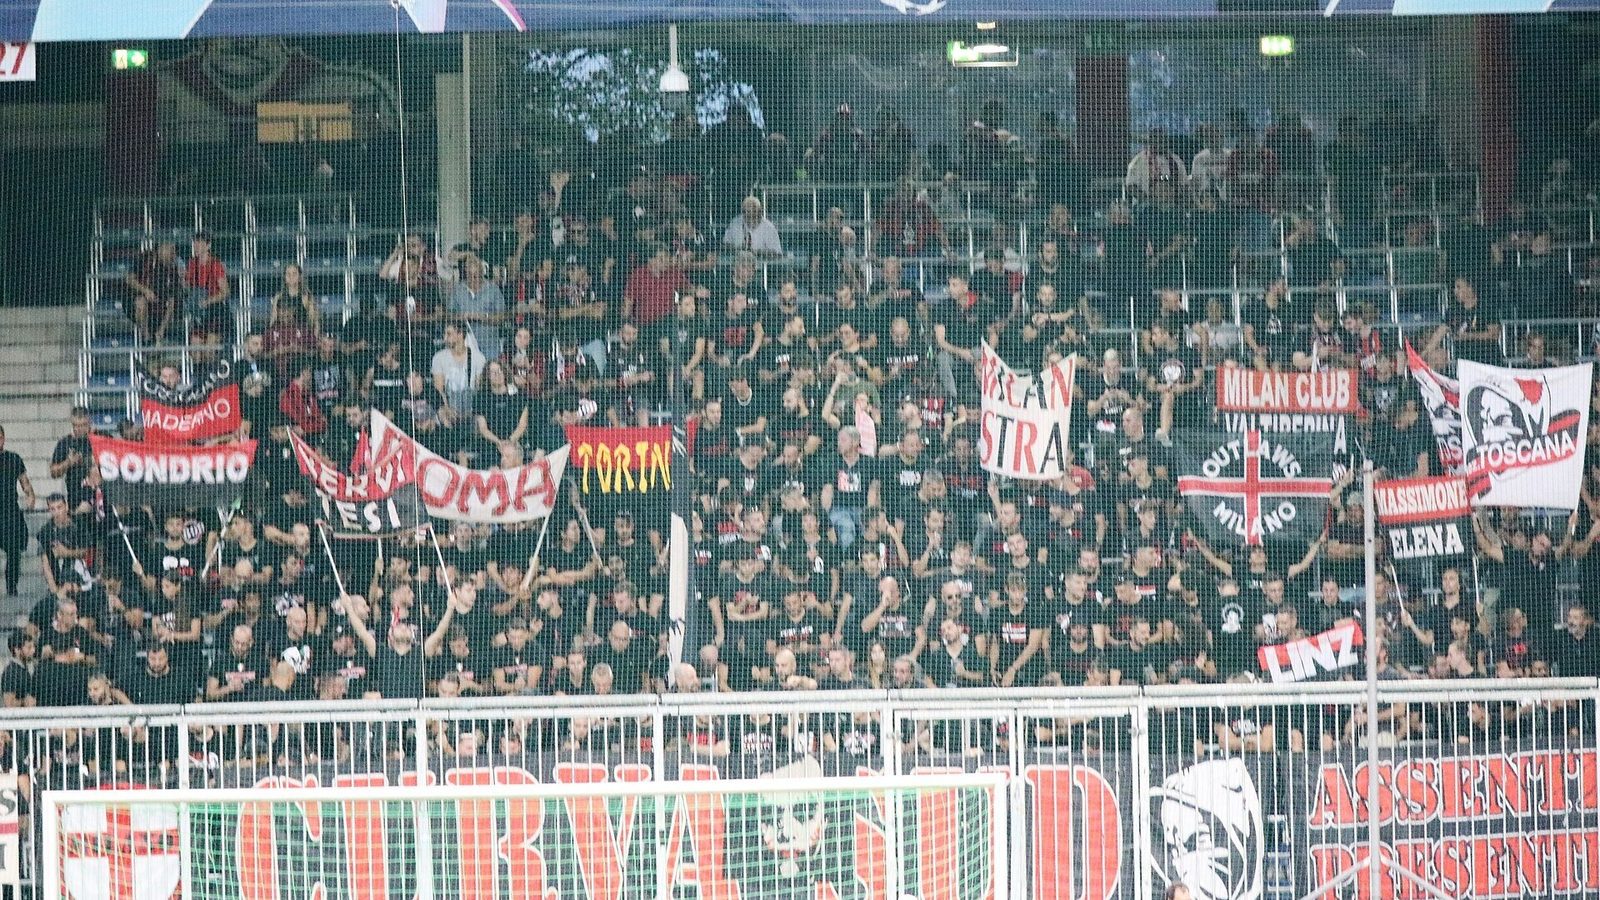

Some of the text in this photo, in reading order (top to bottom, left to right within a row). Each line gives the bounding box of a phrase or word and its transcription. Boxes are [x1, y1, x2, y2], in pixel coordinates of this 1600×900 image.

[1224, 368, 1350, 409] MILAN CLUB
[98, 451, 249, 485] SONDRIO
[1476, 429, 1576, 469] TOSCANA
[1374, 479, 1468, 517] MASSIMONE
[1212, 500, 1297, 537] MILANO
[1388, 523, 1465, 559] ELENA
[1263, 624, 1359, 684] LINZ
[1308, 748, 1600, 830] ASSENTI
